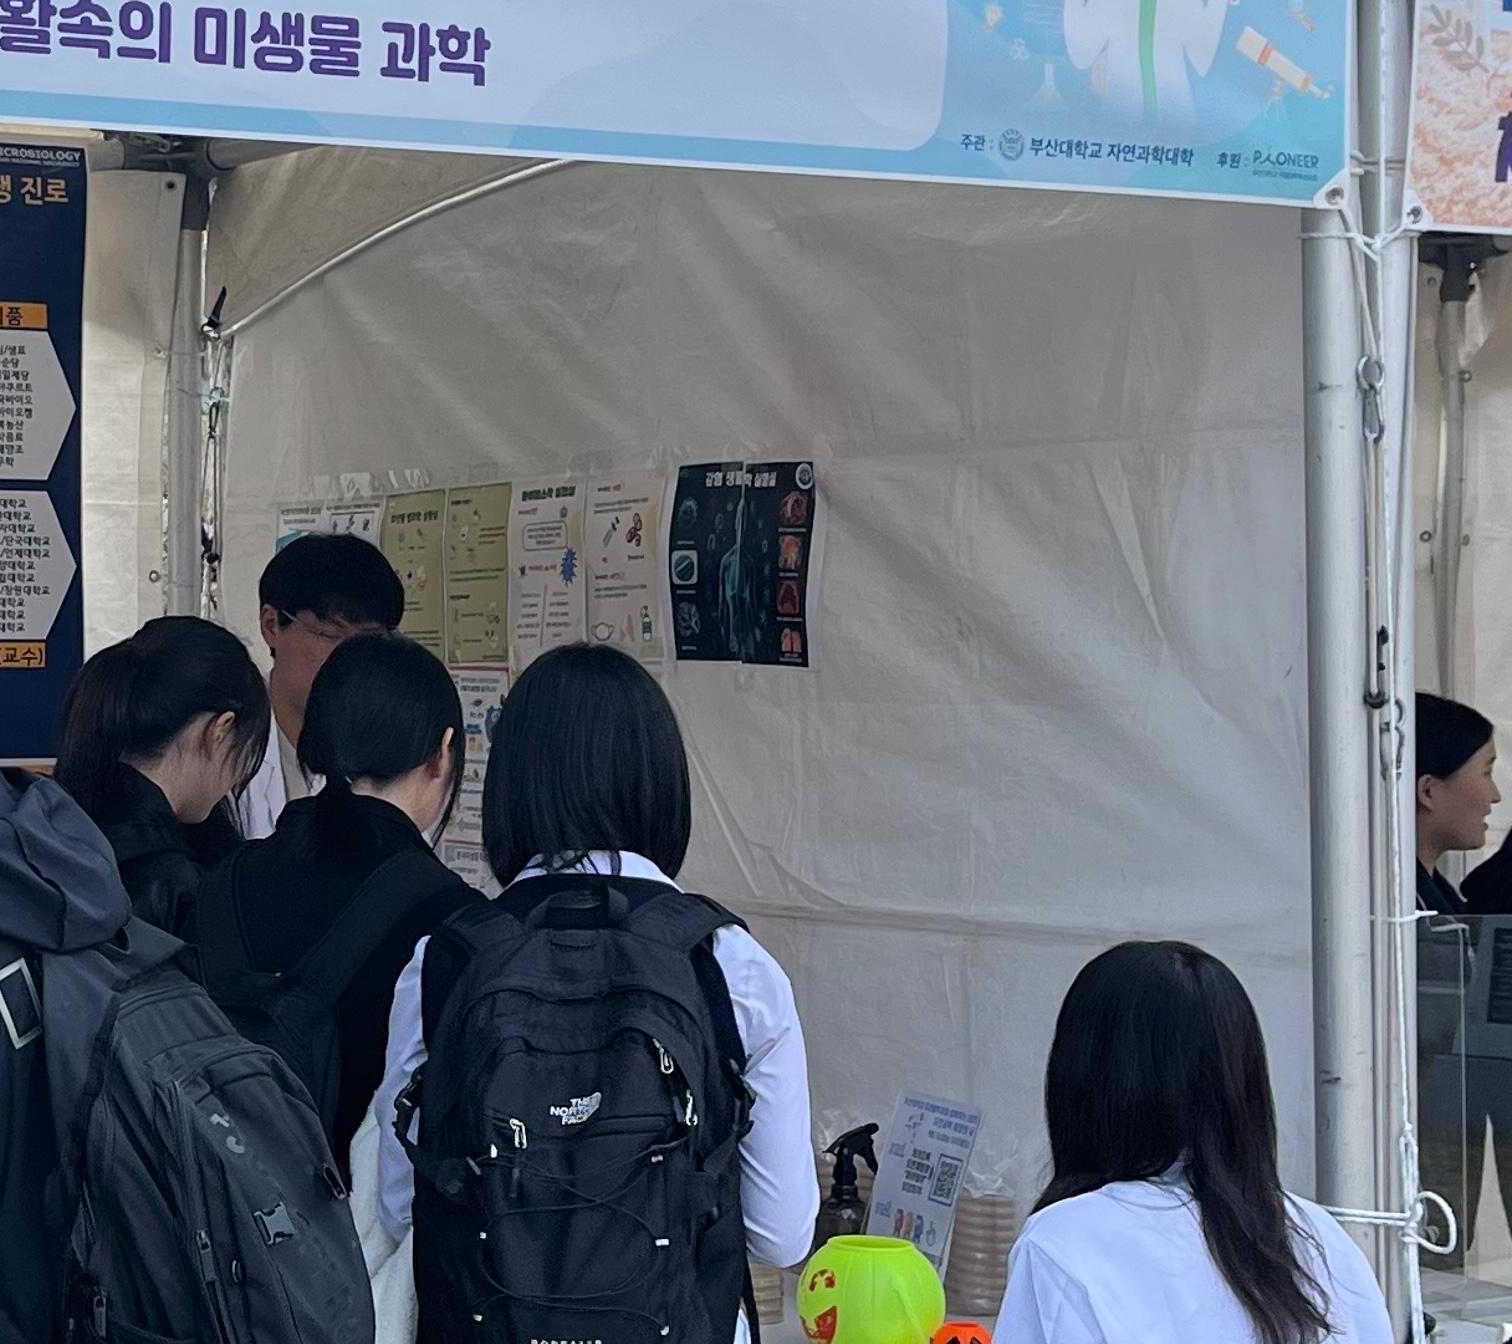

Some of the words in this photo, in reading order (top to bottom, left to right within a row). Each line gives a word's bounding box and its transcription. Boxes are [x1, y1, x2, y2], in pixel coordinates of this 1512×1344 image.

[192, 7, 361, 77] 미생물
[379, 21, 492, 87] 과학
[1029, 138, 1103, 159] 부산대학교
[1107, 143, 1194, 167] 자연과학대학
[20, 176, 69, 205] 진로
